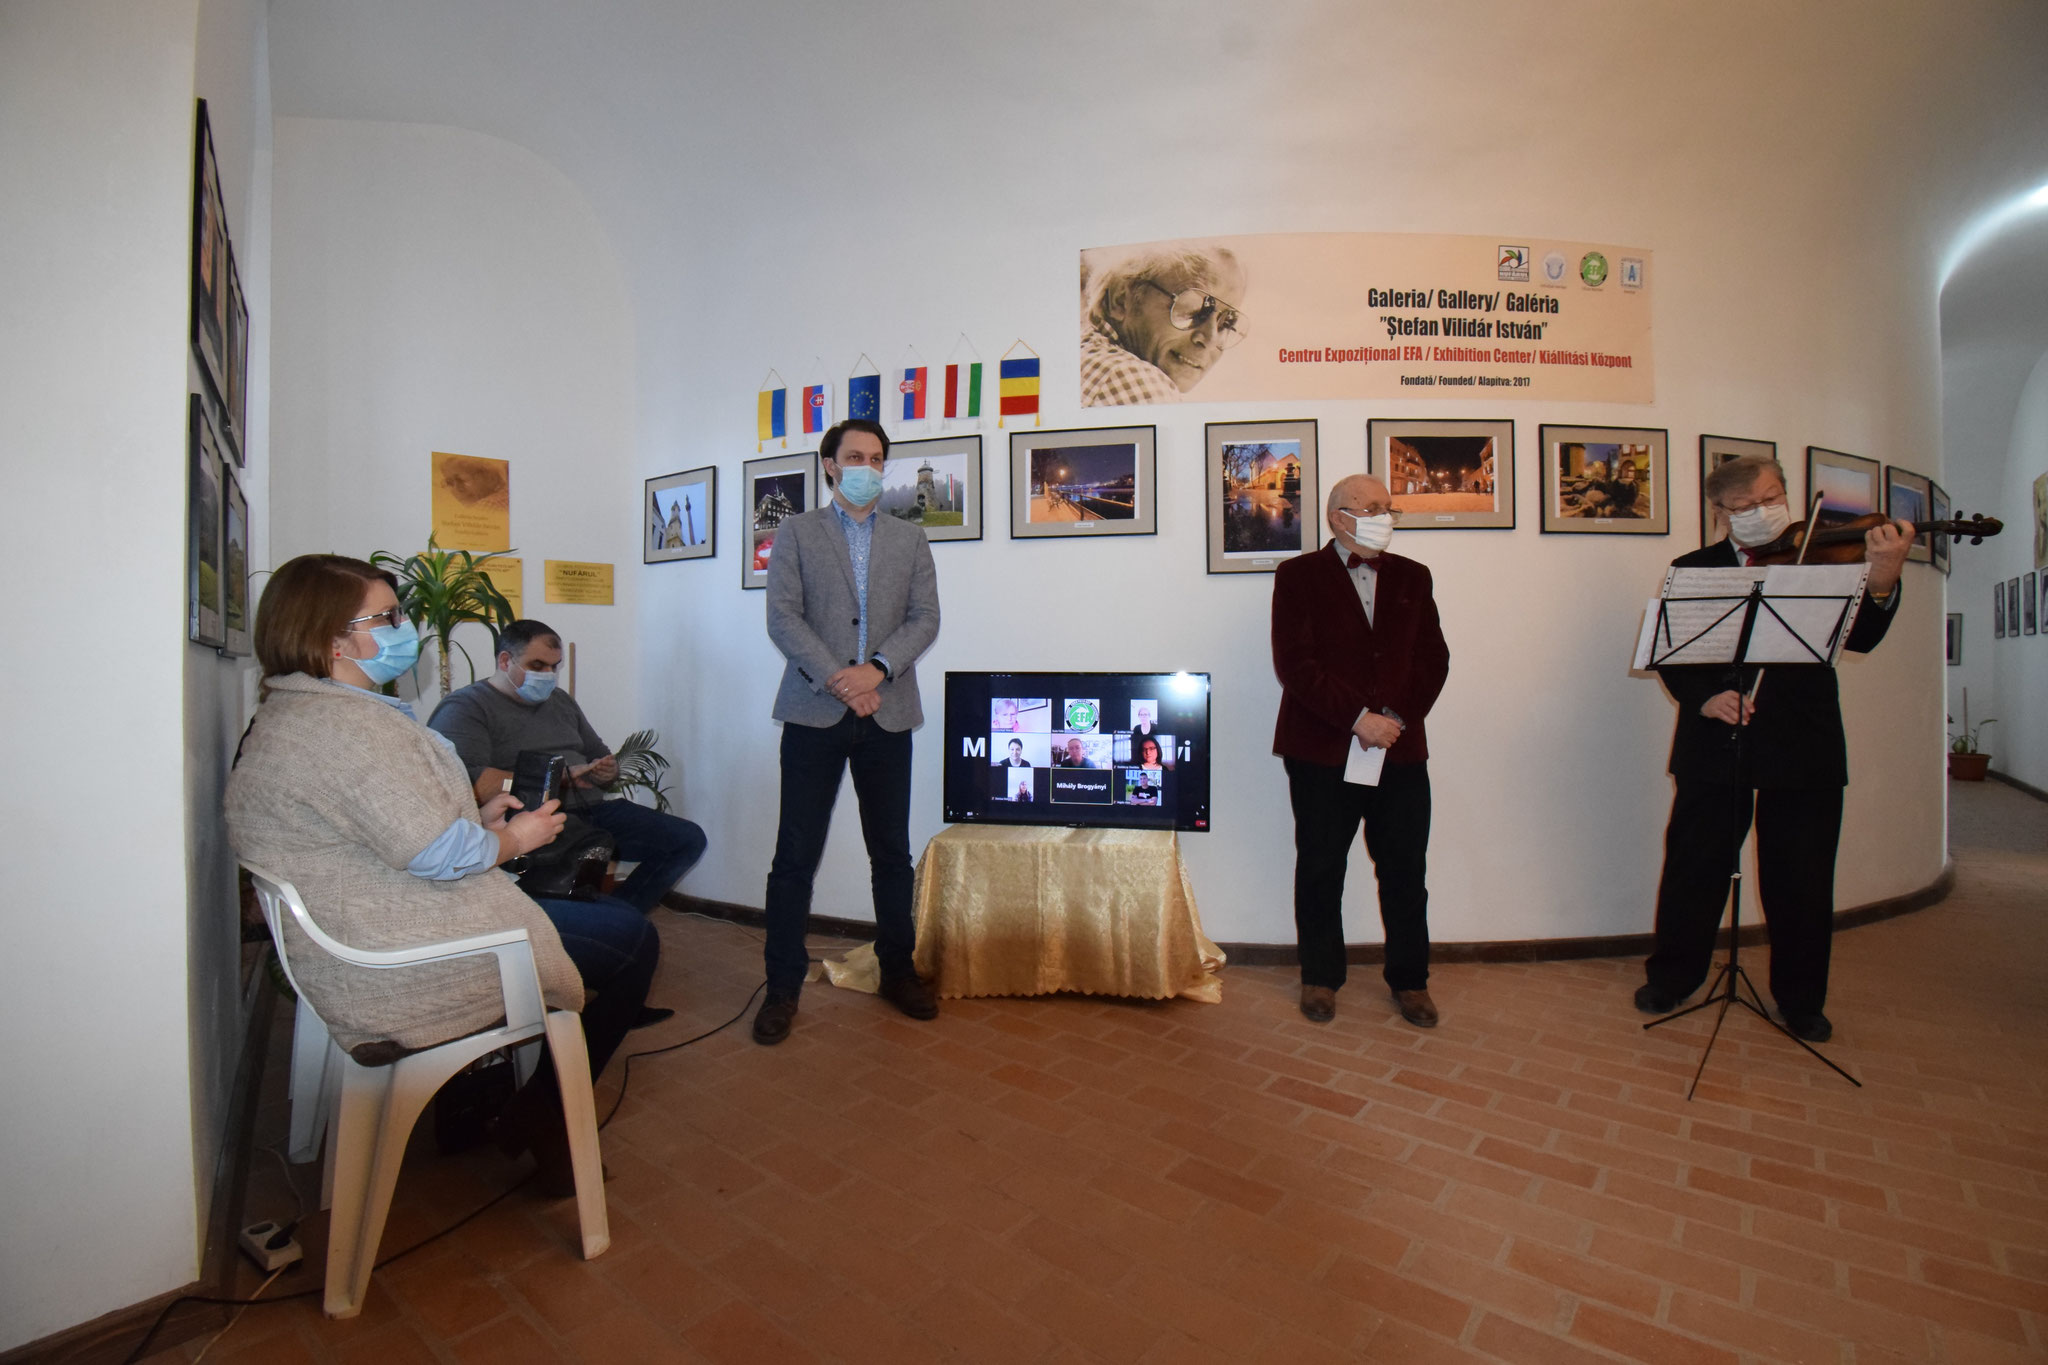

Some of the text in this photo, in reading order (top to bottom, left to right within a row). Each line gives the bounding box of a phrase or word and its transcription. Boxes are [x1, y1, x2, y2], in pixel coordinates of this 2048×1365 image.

[1368, 288, 1559, 314] Galeria/ Gallery/ Galéria
[1442, 317, 1493, 338] Vilidár
[1279, 348, 1322, 363] Centru
[1325, 346, 1401, 365] Expozițional
[1403, 346, 1423, 361] EFA
[1433, 347, 1491, 362] Exhibition
[1493, 348, 1537, 364] Center/
[1539, 350, 1589, 366] Kiállítási
[1590, 352, 1633, 368] Központ
[1438, 375, 1477, 386] Founded/
[1513, 376, 1531, 387] 2017
[1056, 783, 1107, 791] Mihály Brogyányi
